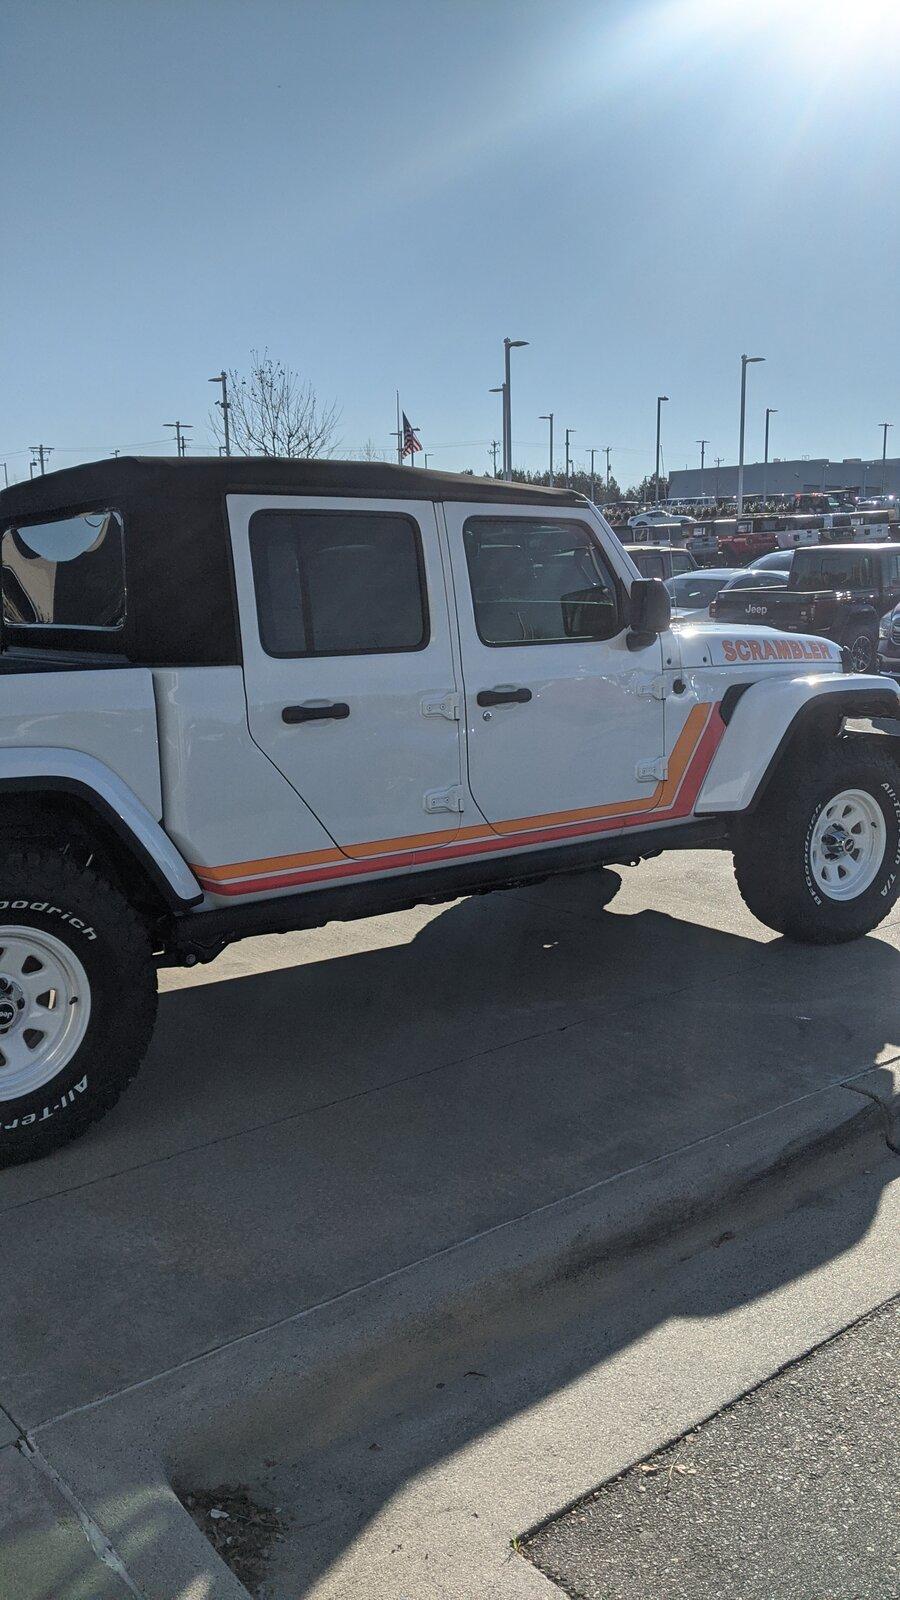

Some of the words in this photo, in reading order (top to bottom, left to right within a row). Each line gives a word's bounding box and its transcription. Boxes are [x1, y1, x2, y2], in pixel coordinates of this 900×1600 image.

[745, 604, 768, 616] Jeep
[722, 639, 833, 662] SCRAMBLER
[880, 873, 897, 897] T/A
[0, 1074, 88, 1130] All-Ter
